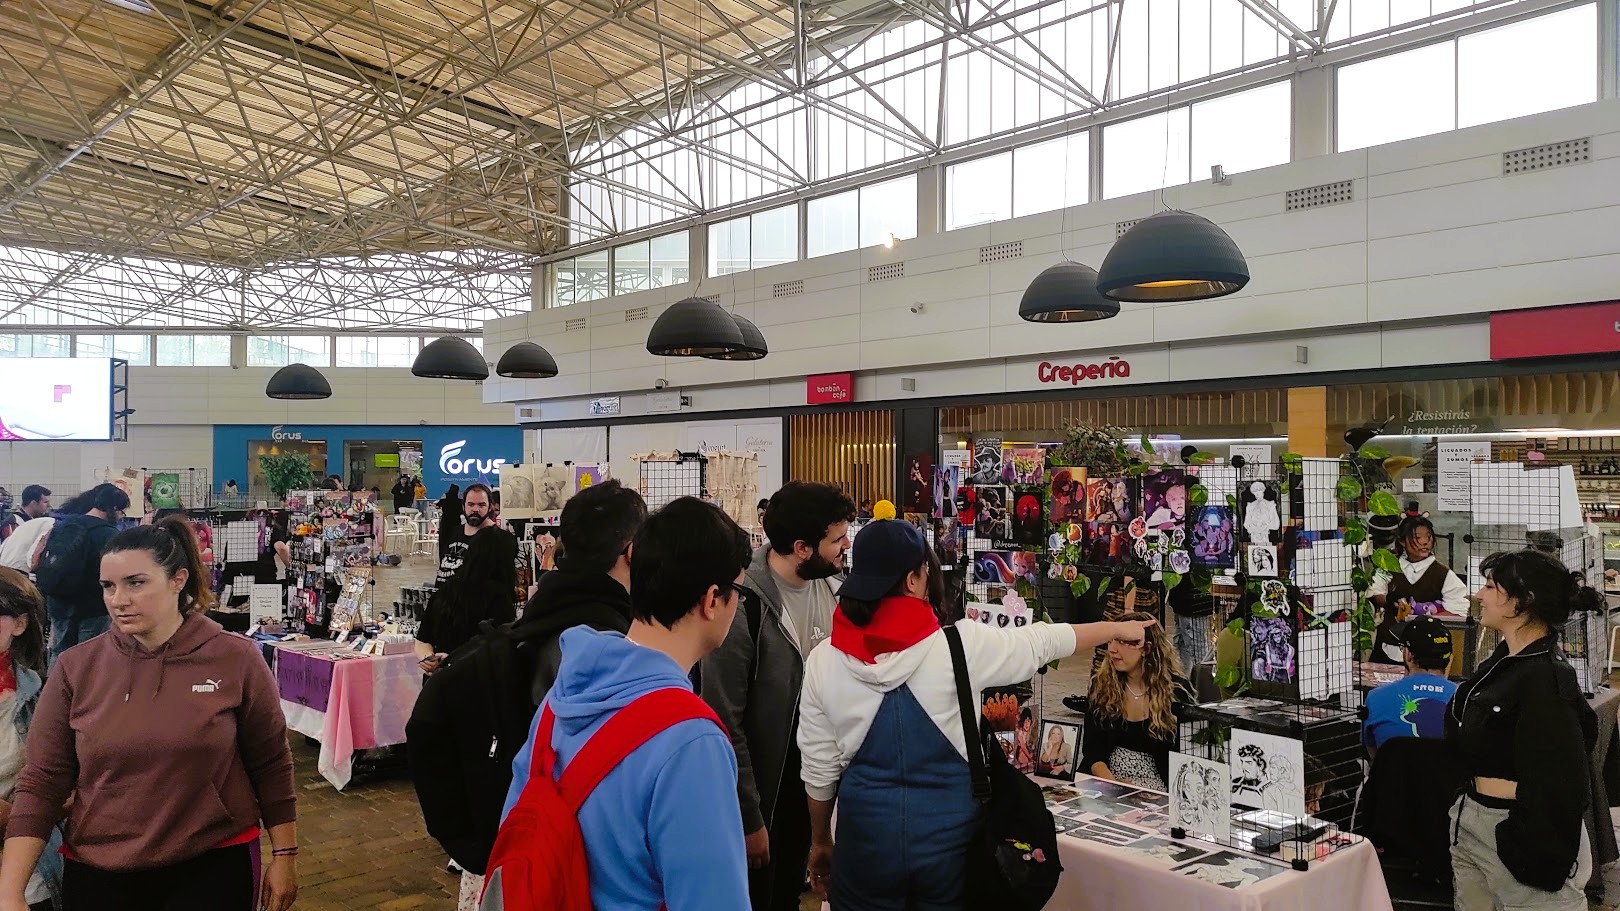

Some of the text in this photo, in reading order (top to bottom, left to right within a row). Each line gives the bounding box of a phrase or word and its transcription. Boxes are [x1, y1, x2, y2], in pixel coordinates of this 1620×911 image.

[1408, 409, 1470, 422] ¿Resistirás
[272, 425, 302, 441] Forus
[1402, 424, 1478, 434] la tentación?
[440, 440, 506, 474] Forus
[192, 684, 215, 693] PUMA
